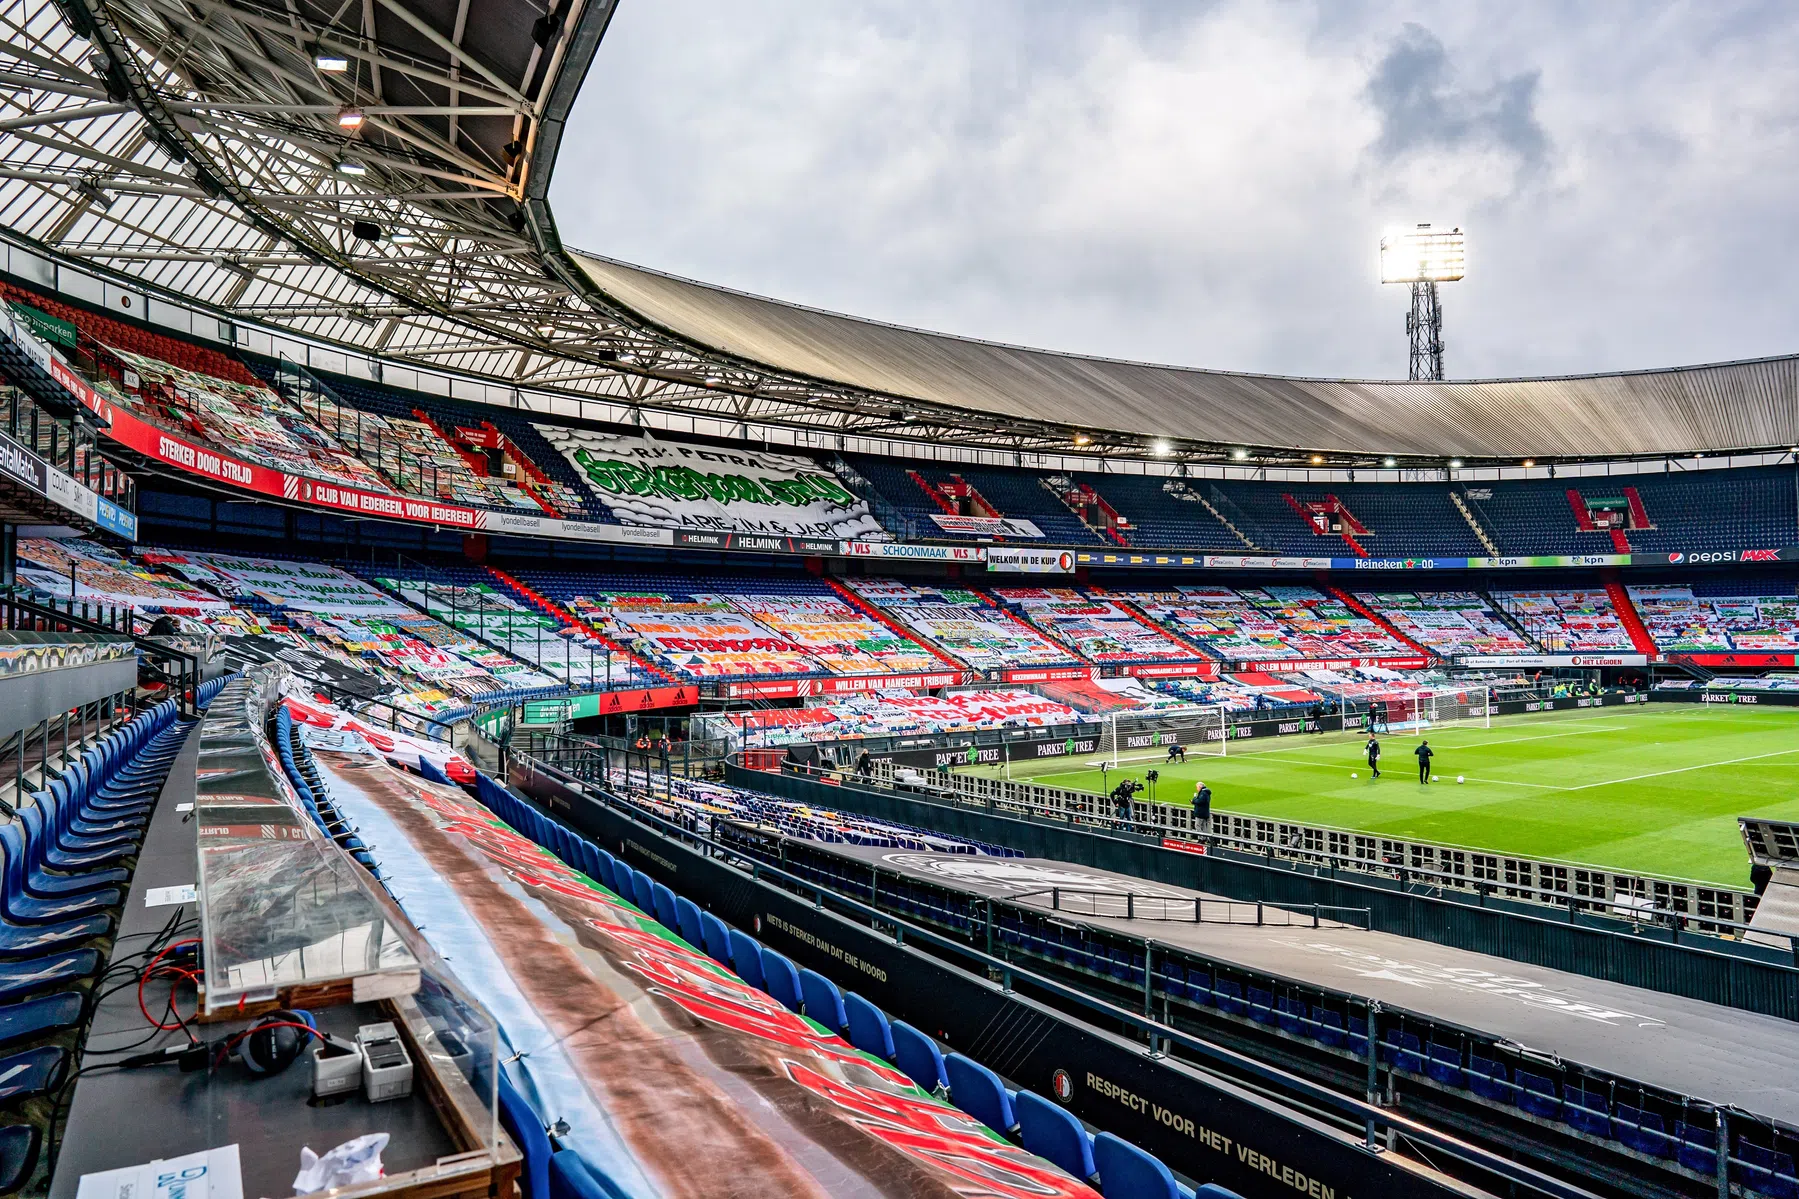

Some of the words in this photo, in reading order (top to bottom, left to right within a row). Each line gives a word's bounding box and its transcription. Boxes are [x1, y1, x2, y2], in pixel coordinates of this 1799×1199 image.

[159, 436, 195, 468] STERKER
[197, 451, 221, 474] DOOR
[222, 460, 252, 484] STRIJD
[676, 446, 765, 469] PETRA
[316, 486, 338, 504] CLUB
[340, 492, 358, 508] VAN
[360, 495, 404, 518] IEDEREEN,
[406, 502, 429, 519] VOOR
[431, 508, 473, 524] IEDEREEN
[501, 515, 540, 528] lyondellbasell
[561, 522, 600, 533] lyondellbasell
[621, 527, 660, 538] lyondellbasell
[688, 535, 719, 544] HELMINK
[738, 537, 781, 550] HELMINK
[805, 542, 833, 551] HELMINK
[854, 543, 871, 554] VLS
[883, 545, 947, 558] SCHOONMAAK
[953, 548, 968, 559] VLS
[1689, 550, 1736, 563] pepsi
[1740, 549, 1782, 561] MAX
[989, 555, 1019, 564] WELKOM
[1021, 556, 1028, 564] IN
[1030, 556, 1039, 565] DE
[1041, 557, 1056, 565] KUIP
[1355, 559, 1403, 569] Heineken
[1499, 558, 1517, 566] kpn
[1584, 557, 1603, 565] kpn
[1280, 662, 1293, 671] VAN
[1294, 661, 1324, 671] HANEGEM
[1325, 661, 1352, 669] TRIBUNE
[835, 680, 866, 691] WILLEM
[868, 679, 884, 689] VAN
[885, 677, 921, 688] HANEGEM
[923, 675, 954, 686] TRIBUNE
[1702, 694, 1729, 702] PARKET
[1738, 695, 1758, 703] TREE
[639, 701, 655, 709] adidas
[1344, 717, 1361, 726] PARKET
[1236, 727, 1252, 737] TREE
[1278, 722, 1299, 733] PARKET
[1128, 736, 1153, 747] PARKET
[1161, 733, 1178, 744] TREE
[1037, 744, 1066, 756] PARKET
[1074, 740, 1094, 752] TREE
[977, 749, 999, 762] TREE
[766, 912, 782, 929] NIETS
[783, 920, 789, 932] IS
[789, 924, 815, 946] STERKER
[816, 938, 829, 954] DAN
[830, 945, 843, 960] DAT
[844, 952, 858, 968] ENE
[859, 959, 887, 983] WOORD
[1086, 1071, 1148, 1115] RESPECT
[1152, 1103, 1195, 1139] VOOR
[1200, 1125, 1233, 1156] HET
[1236, 1143, 1335, 1199] VERLEDEN
